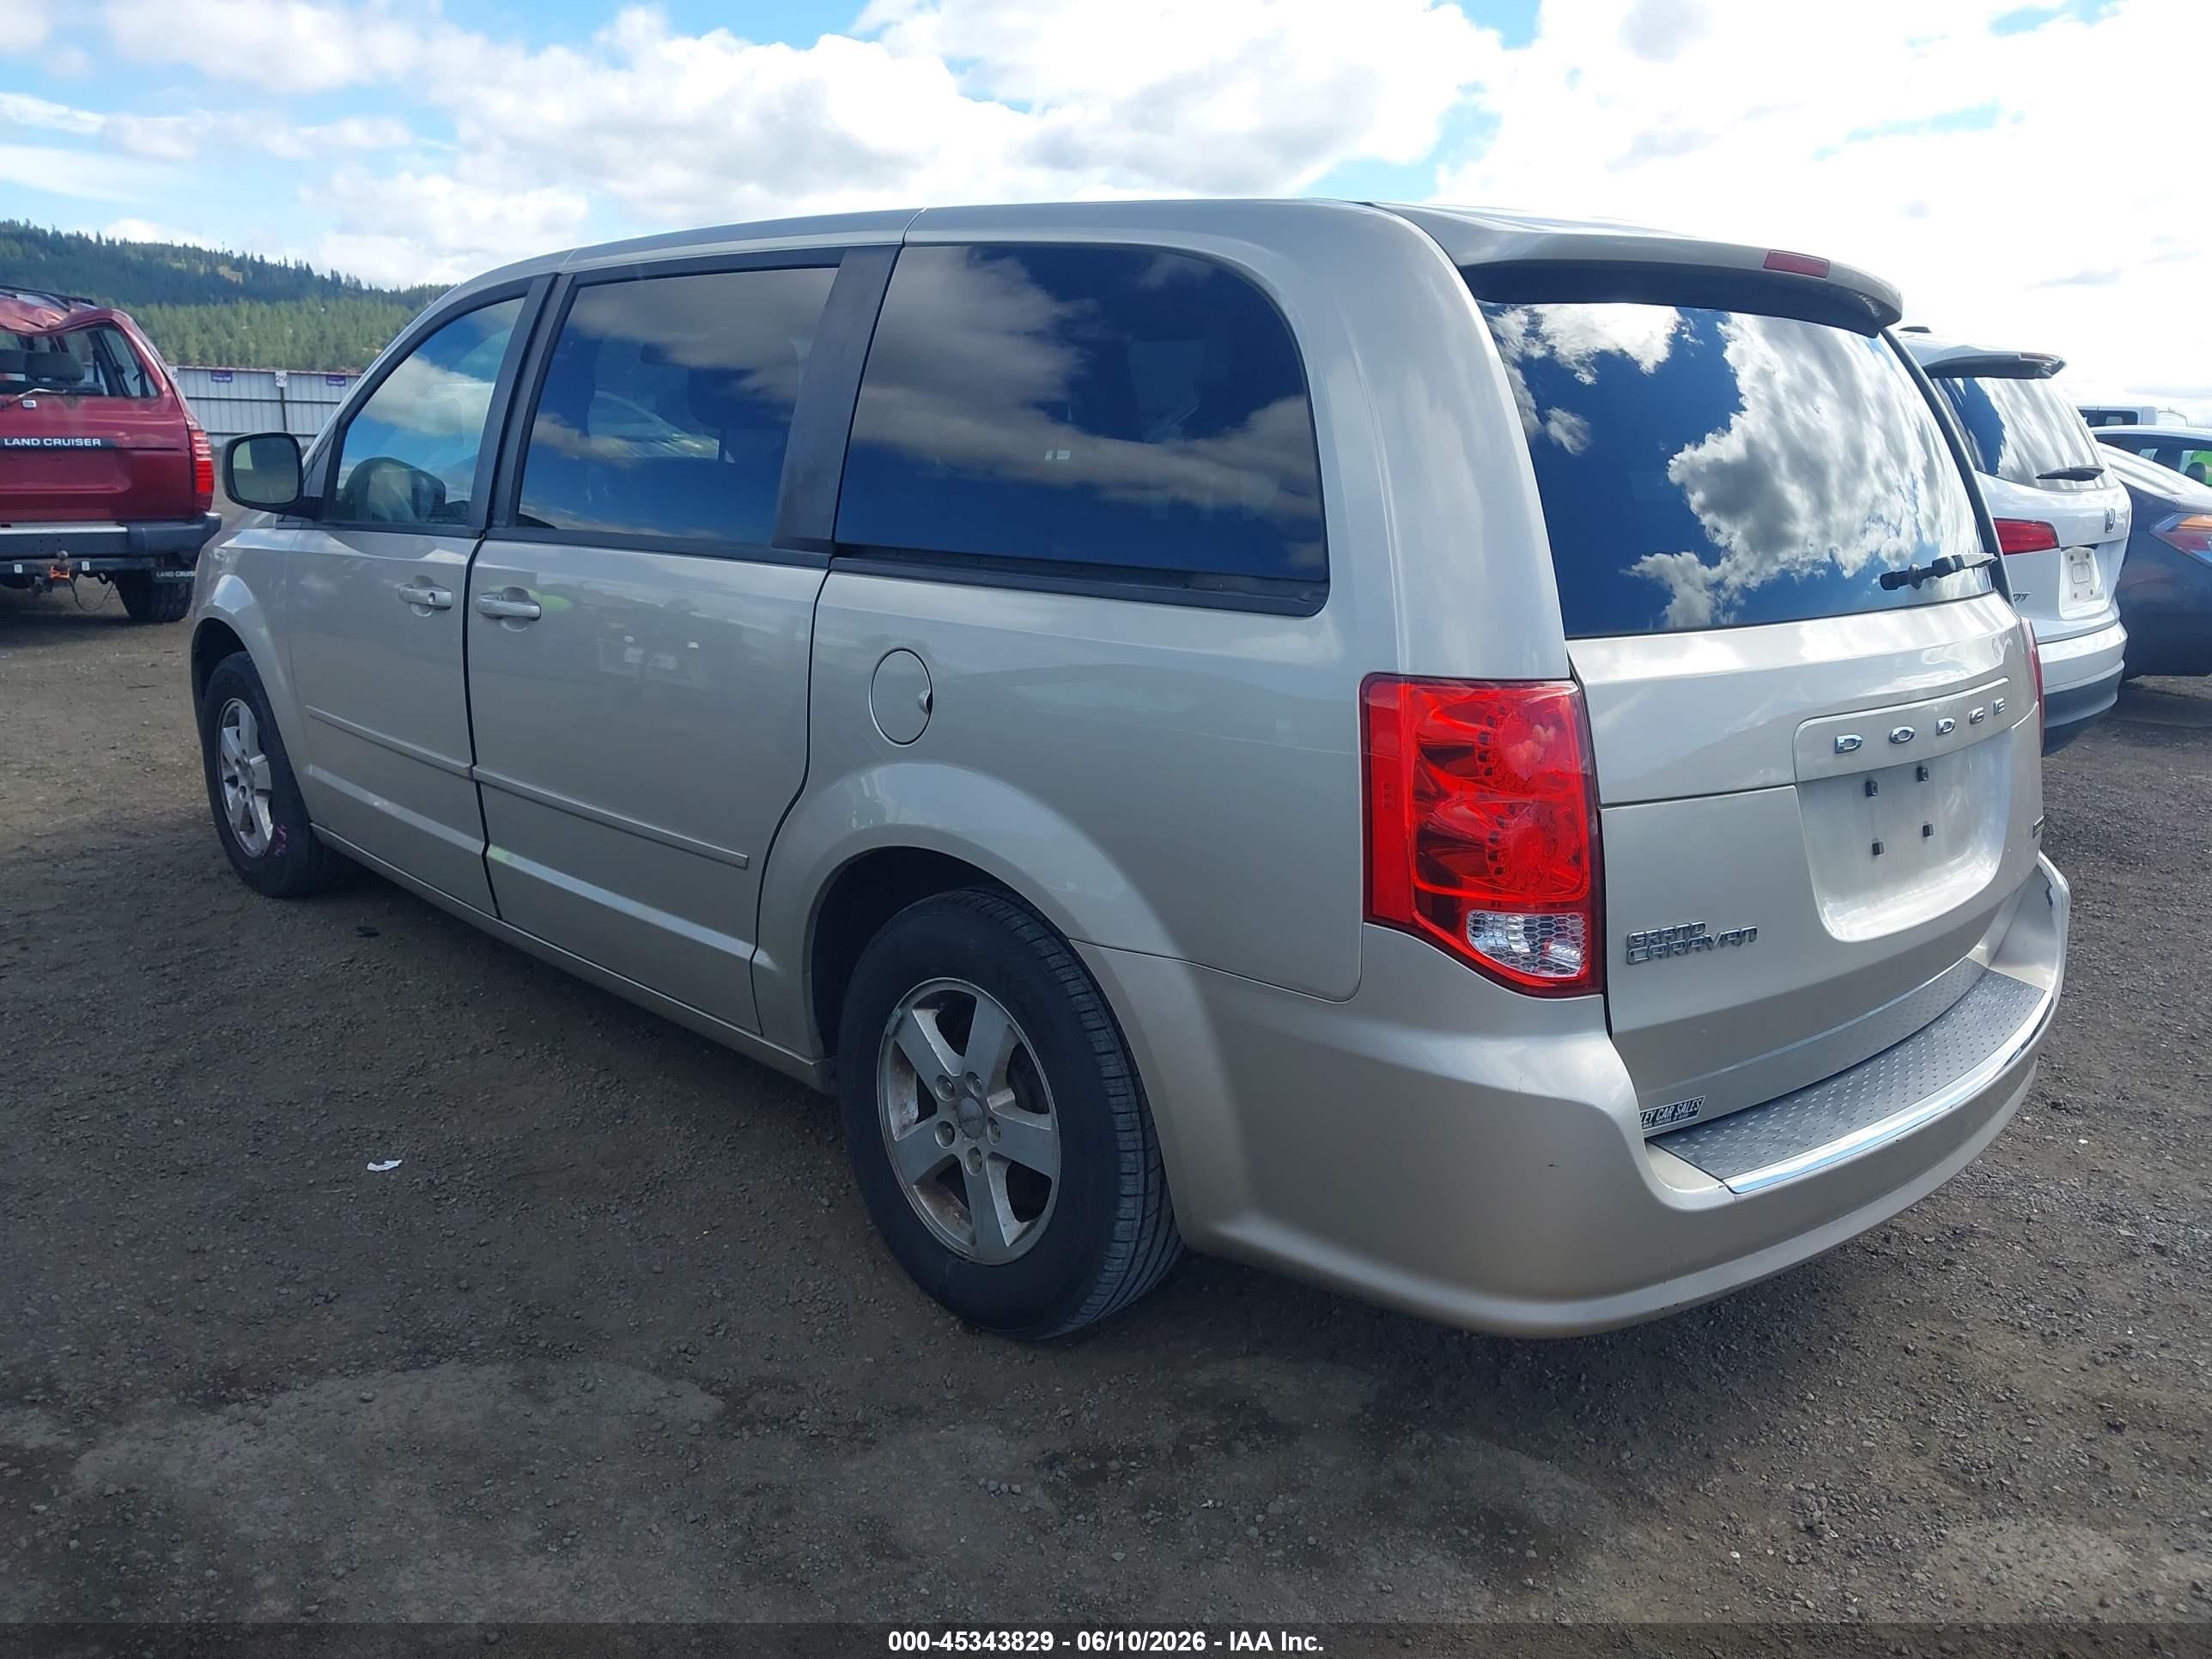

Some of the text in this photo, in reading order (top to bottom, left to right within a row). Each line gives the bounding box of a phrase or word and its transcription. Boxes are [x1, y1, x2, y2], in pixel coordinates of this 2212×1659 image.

[43, 438, 101, 447] CRUISER
[1834, 697, 2005, 754] DODGE
[1626, 926, 1758, 964] CARAVAN
[1627, 921, 1706, 948] GRAND
[1656, 1105, 1674, 1121] CAR
[1675, 1098, 1702, 1115] SALES
